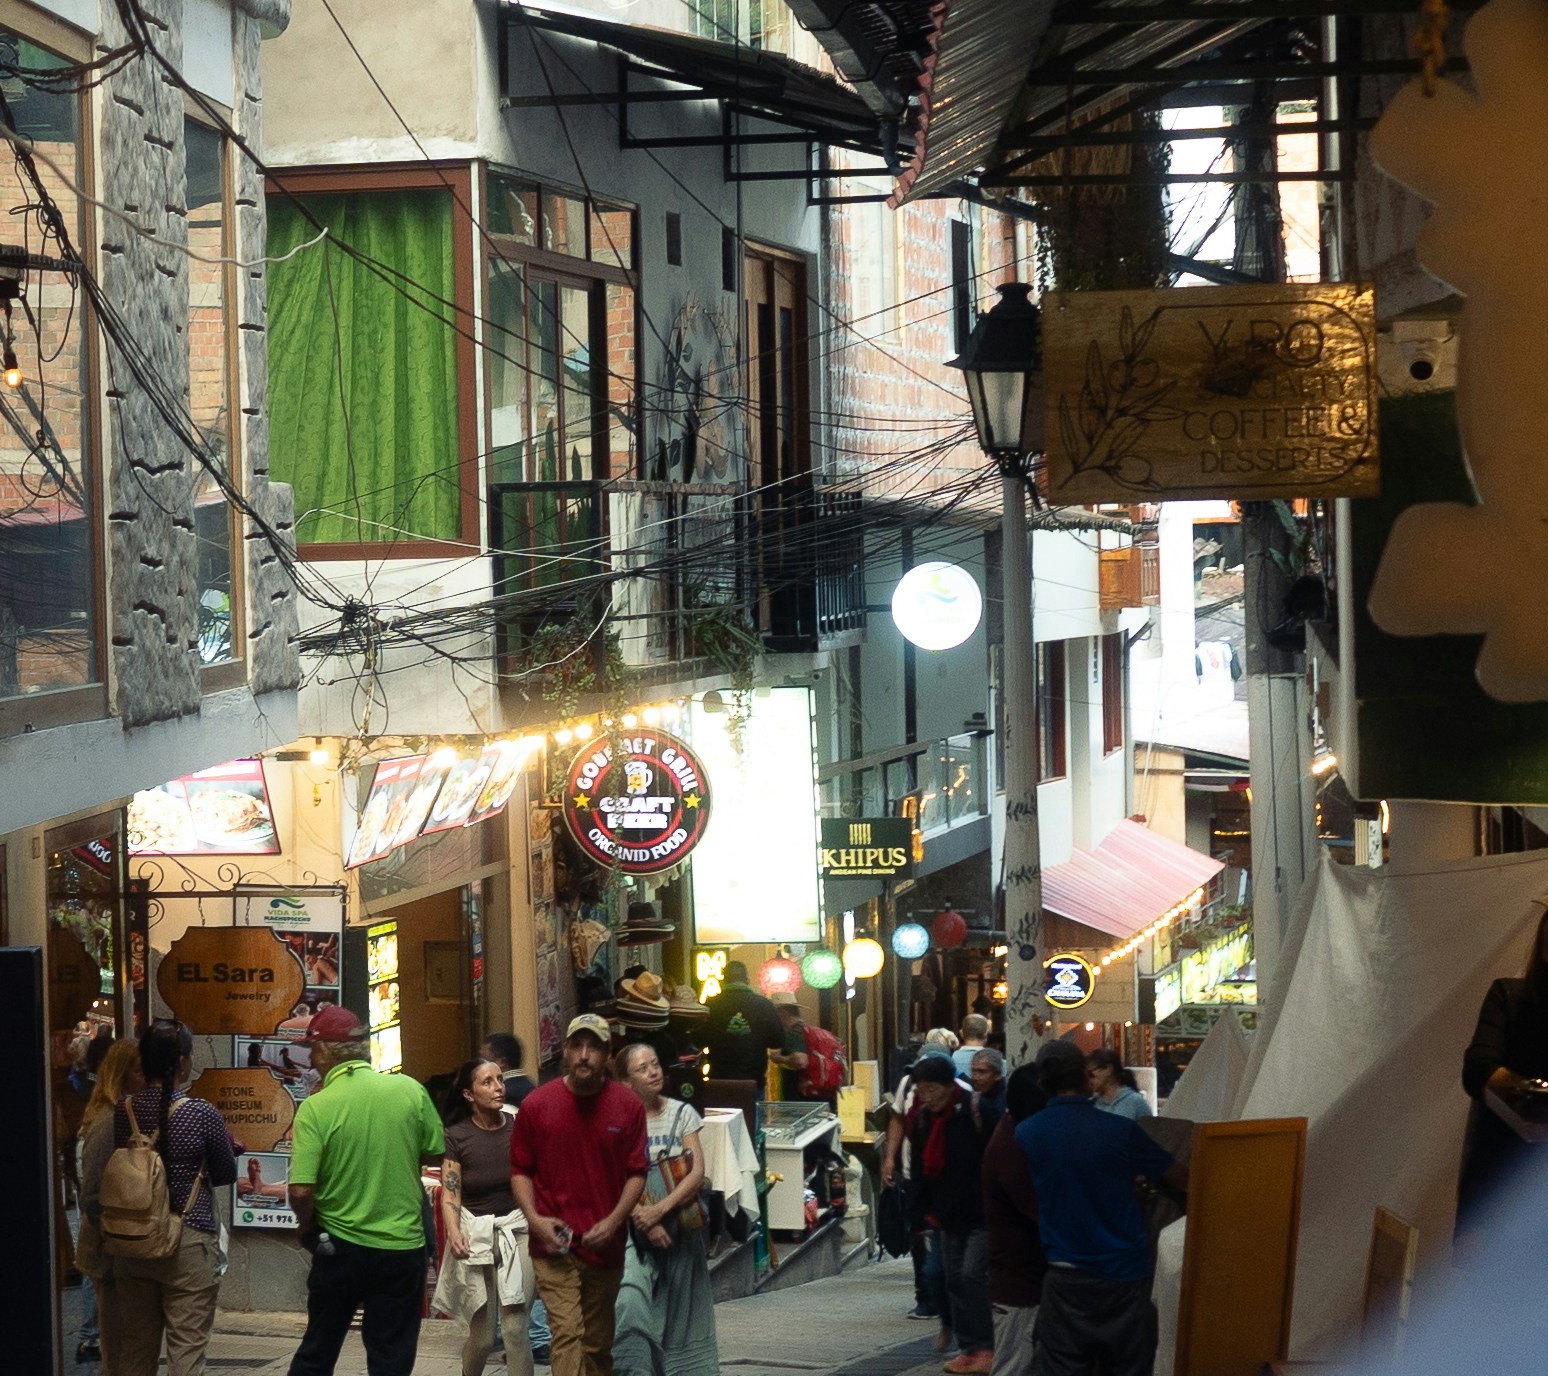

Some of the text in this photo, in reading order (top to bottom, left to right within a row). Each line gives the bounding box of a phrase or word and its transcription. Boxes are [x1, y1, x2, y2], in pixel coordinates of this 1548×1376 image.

[1182, 405, 1366, 442] COFFEE &
[1201, 446, 1348, 474] DESSERTS
[661, 748, 699, 792] GRILL
[599, 796, 676, 813] CRAFT
[651, 827, 688, 860] FOOD
[822, 847, 907, 867] KHIPUS
[177, 962, 275, 983] EL Sara
[225, 990, 271, 1003] Jewelry
[219, 1086, 255, 1097] STONE
[217, 1099, 263, 1111] MUSEUM
[224, 1113, 278, 1124] HUPICCHU
